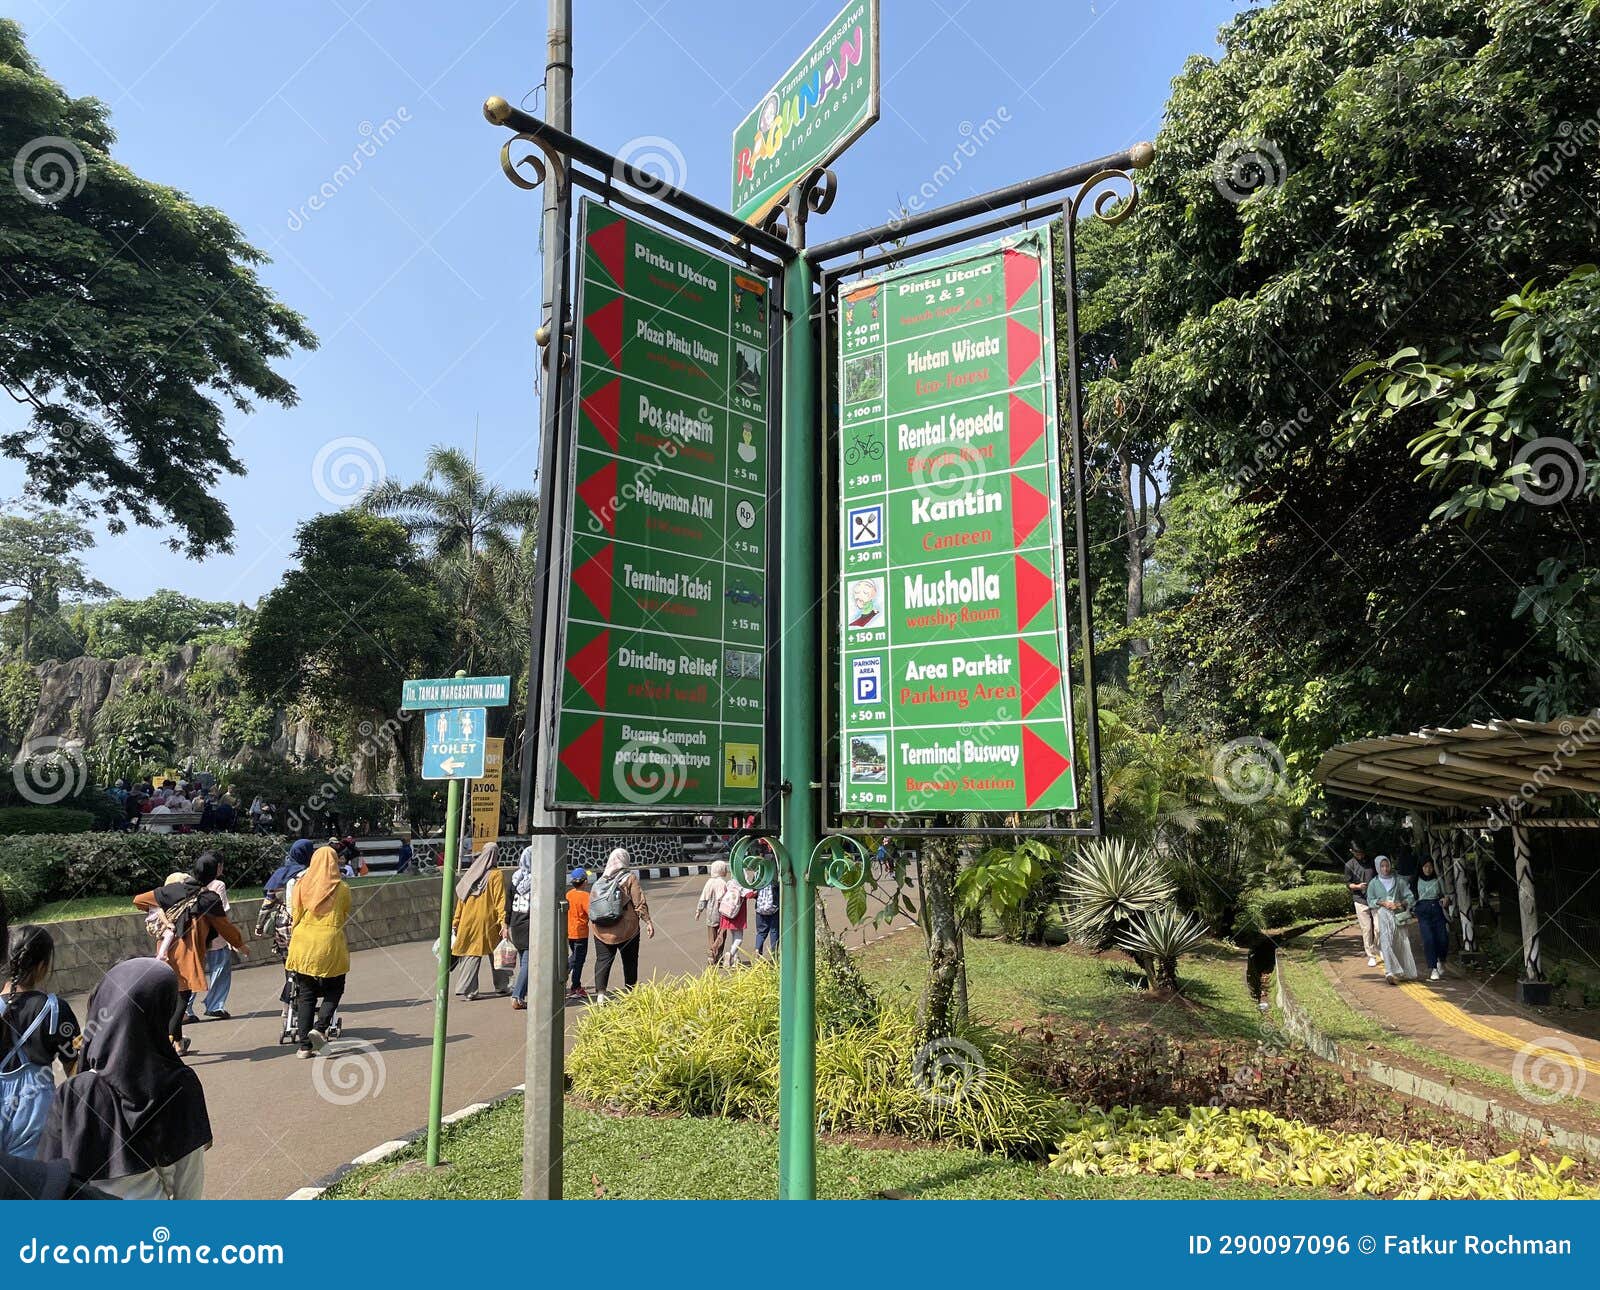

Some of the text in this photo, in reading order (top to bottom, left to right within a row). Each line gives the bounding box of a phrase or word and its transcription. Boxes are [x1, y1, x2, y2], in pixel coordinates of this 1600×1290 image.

[781, 5, 864, 98] Taman Margasatwa
[737, 25, 863, 186] RAGUNAN
[737, 158, 780, 207] Jakarta
[792, 77, 863, 151] Indonesia
[634, 242, 674, 273] Pintu
[678, 261, 717, 291] Utara
[899, 265, 992, 296] Pintu Utara
[926, 287, 965, 305] 2 & 3
[742, 323, 752, 334] 10
[754, 329, 762, 339] m
[854, 324, 868, 336] 40
[870, 322, 880, 332] m
[637, 319, 664, 346] Plaza
[666, 330, 691, 356] Pintu
[693, 340, 719, 366] Utara
[854, 336, 868, 346] 70
[870, 334, 880, 343] m
[907, 336, 1000, 375] Hutan Wisata
[742, 398, 751, 408] 10
[753, 402, 762, 413] m
[854, 408, 870, 418] 100
[872, 404, 882, 413] m
[639, 394, 713, 444] Pos satpam
[898, 405, 1005, 451] Rental Sepeda
[959, 444, 994, 462] Rent
[741, 469, 747, 478] 5
[748, 471, 758, 482] m
[856, 475, 870, 486] 30
[872, 473, 882, 482] m
[636, 480, 713, 519] Pelayanan ATM
[911, 488, 1002, 525] Kantin
[740, 507, 754, 521] Rp.
[742, 542, 748, 551] 5
[750, 544, 758, 554] m
[922, 529, 992, 551] Canteen
[856, 552, 870, 562] 30
[872, 550, 882, 560] m
[624, 563, 712, 601] Terminal Taksi
[904, 566, 1000, 609] Musholla
[739, 619, 749, 630] 15
[750, 622, 760, 631] m
[906, 605, 1000, 630] worship Room
[856, 632, 872, 642] 150
[875, 632, 886, 641] m
[618, 647, 718, 677] Dinding Relief
[853, 658, 880, 667] PARKING
[905, 654, 1012, 681] Area Parkir
[419, 686, 439, 701] TAMAN
[441, 684, 483, 700] MARGASATWA
[485, 683, 505, 699] UTARA
[860, 679, 874, 697] P
[900, 682, 1017, 709] Parking Area
[736, 697, 747, 707] 10
[749, 699, 759, 708] m
[858, 711, 872, 721] 50
[874, 710, 886, 720] m
[621, 725, 706, 746] Buang Sampah
[431, 743, 477, 754] TOILET
[615, 746, 711, 768] pada tempatnya
[901, 740, 1019, 766] Terminal Busway
[962, 775, 1015, 790] Station
[859, 792, 874, 802] 50
[876, 793, 887, 803] m
